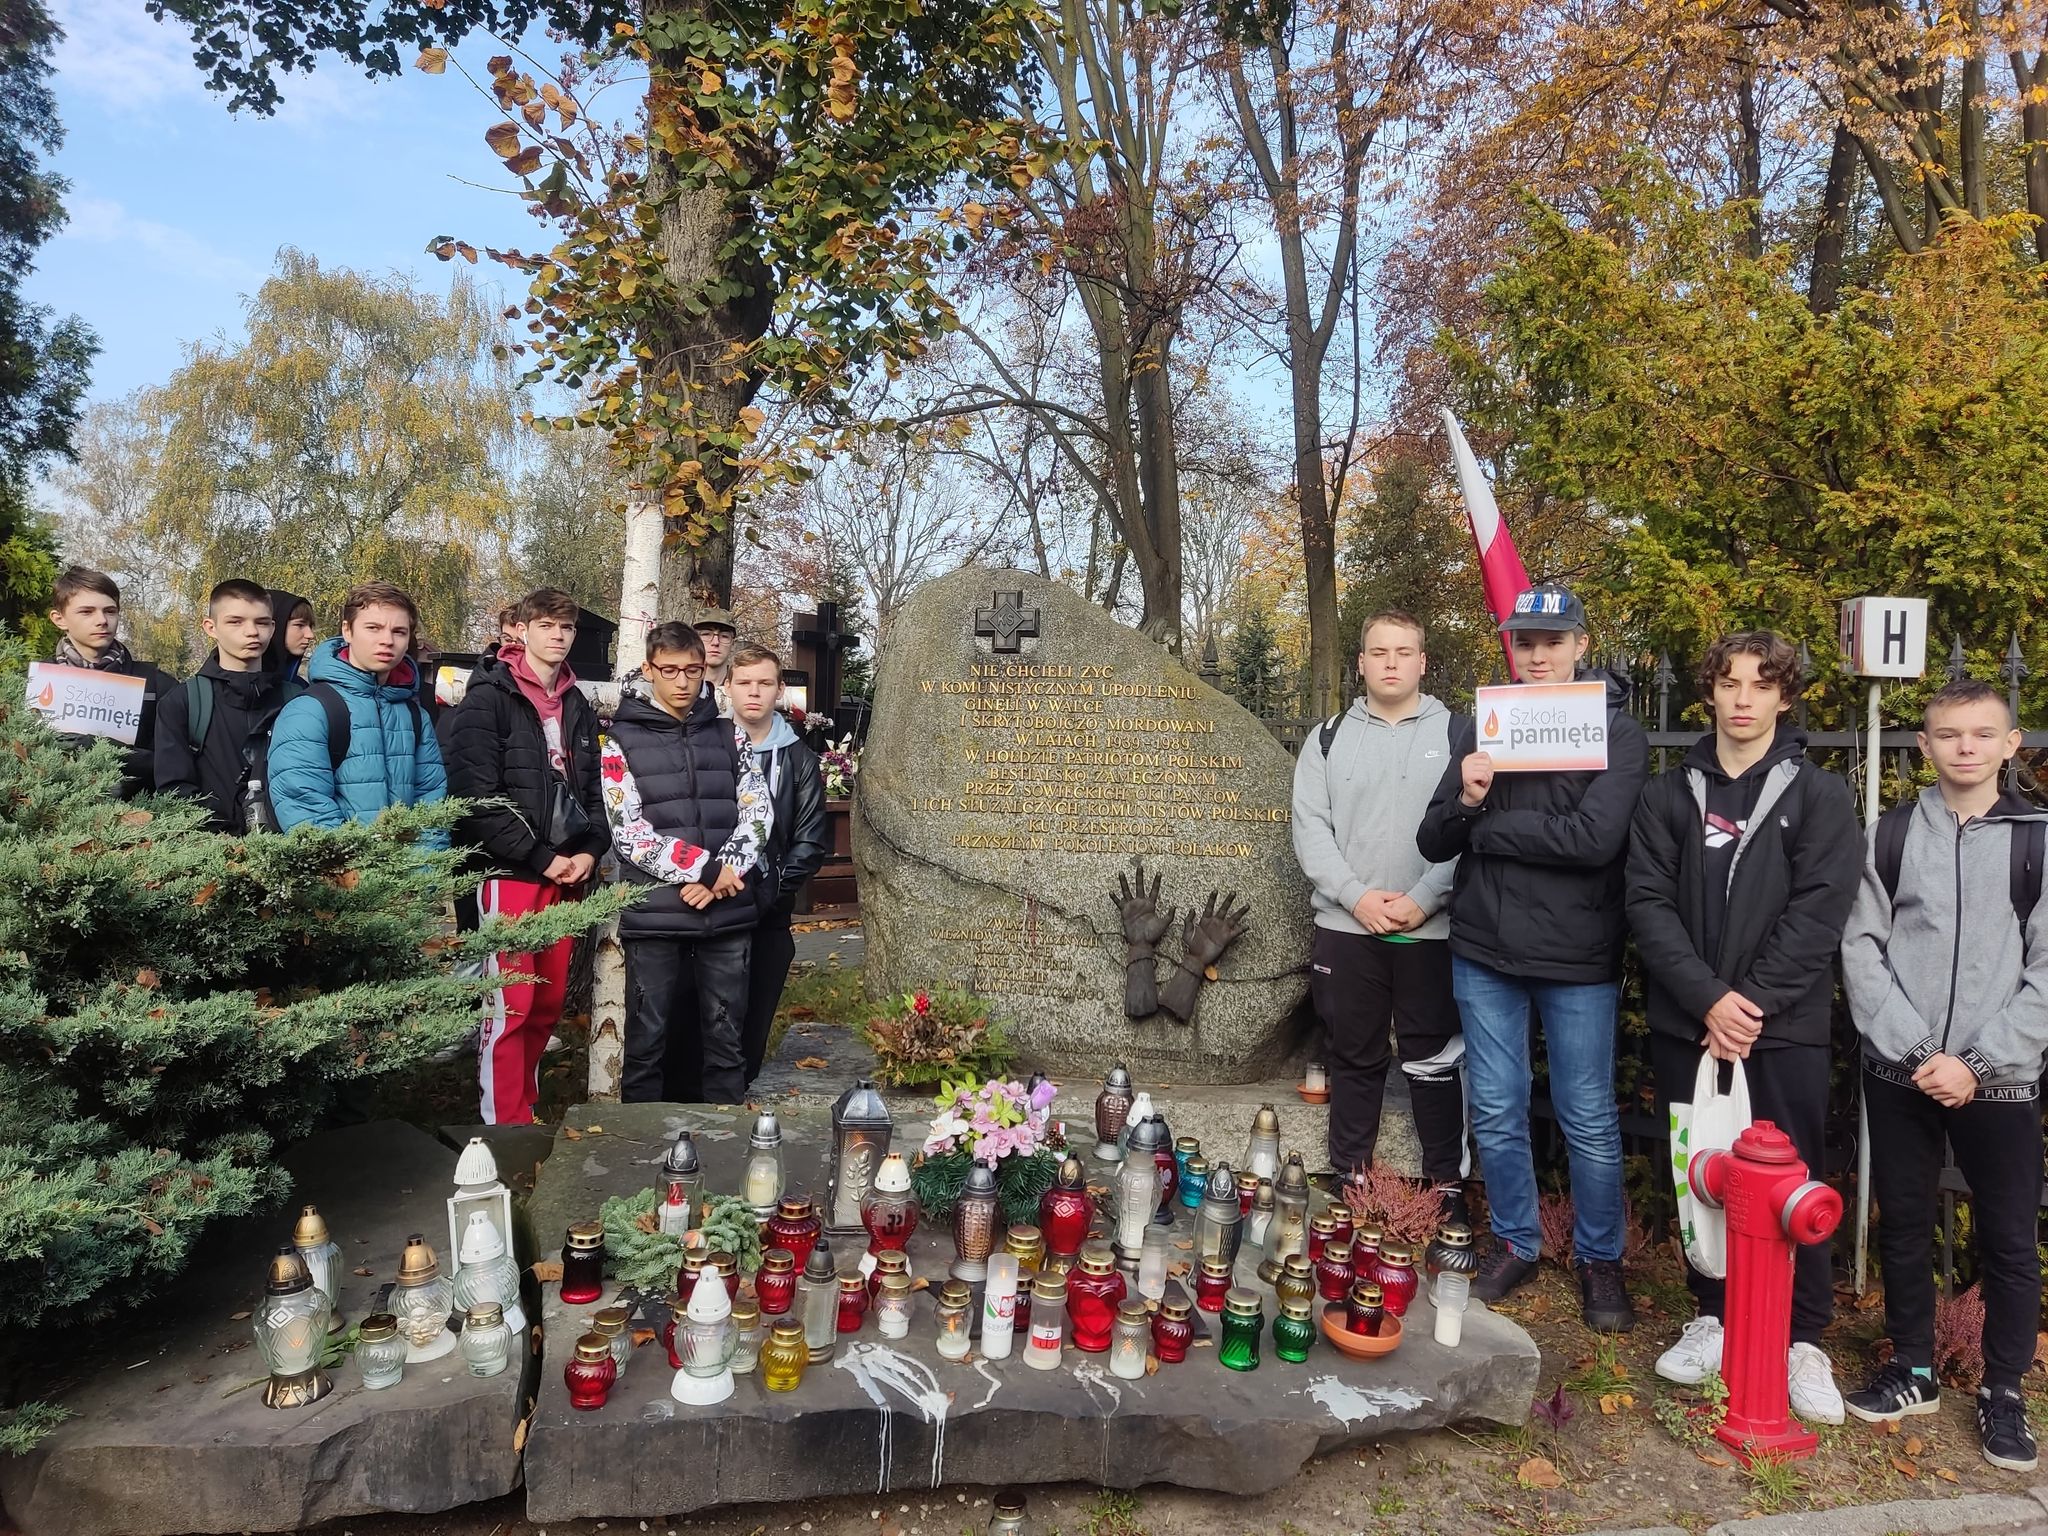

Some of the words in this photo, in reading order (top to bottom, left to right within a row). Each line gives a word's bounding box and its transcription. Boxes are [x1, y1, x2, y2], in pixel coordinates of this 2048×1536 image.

[997, 613, 1015, 626] KS
[1882, 610, 1907, 665] H
[970, 665, 999, 677] NIE
[1006, 665, 1072, 678] CHCIELI
[64, 684, 117, 706] Szkoła
[921, 681, 935, 693] W
[941, 682, 1093, 696] KOMUNISTYCZNYM
[1027, 700, 1041, 712] W
[1050, 700, 1104, 713] WALCE
[61, 702, 141, 729] pamięta
[960, 715, 966, 727] I
[1107, 718, 1215, 733] MORDOWANI
[1510, 707, 1567, 725] Szkoła
[1016, 734, 1031, 746] W
[1036, 735, 1096, 747] LATACH
[1106, 737, 1140, 750] 1939
[1511, 722, 1604, 749] pamięta
[965, 750, 979, 763] W
[1066, 752, 1160, 767] PATRIOTOM
[1168, 755, 1243, 769] POLSKIM
[990, 768, 1087, 782] BESTIALSKO
[965, 782, 1015, 796] PRZEZ
[1024, 785, 1127, 801] SOWIECKICH
[912, 800, 918, 811] I
[924, 799, 952, 812] ICH
[1212, 807, 1293, 823] POLSKICH
[1029, 820, 1050, 832] KU
[1060, 821, 1175, 837] PRZESTRODZE
[1054, 838, 1164, 854] POKOLENIOM
[1984, 1086, 2033, 1100] PLAYTIME
